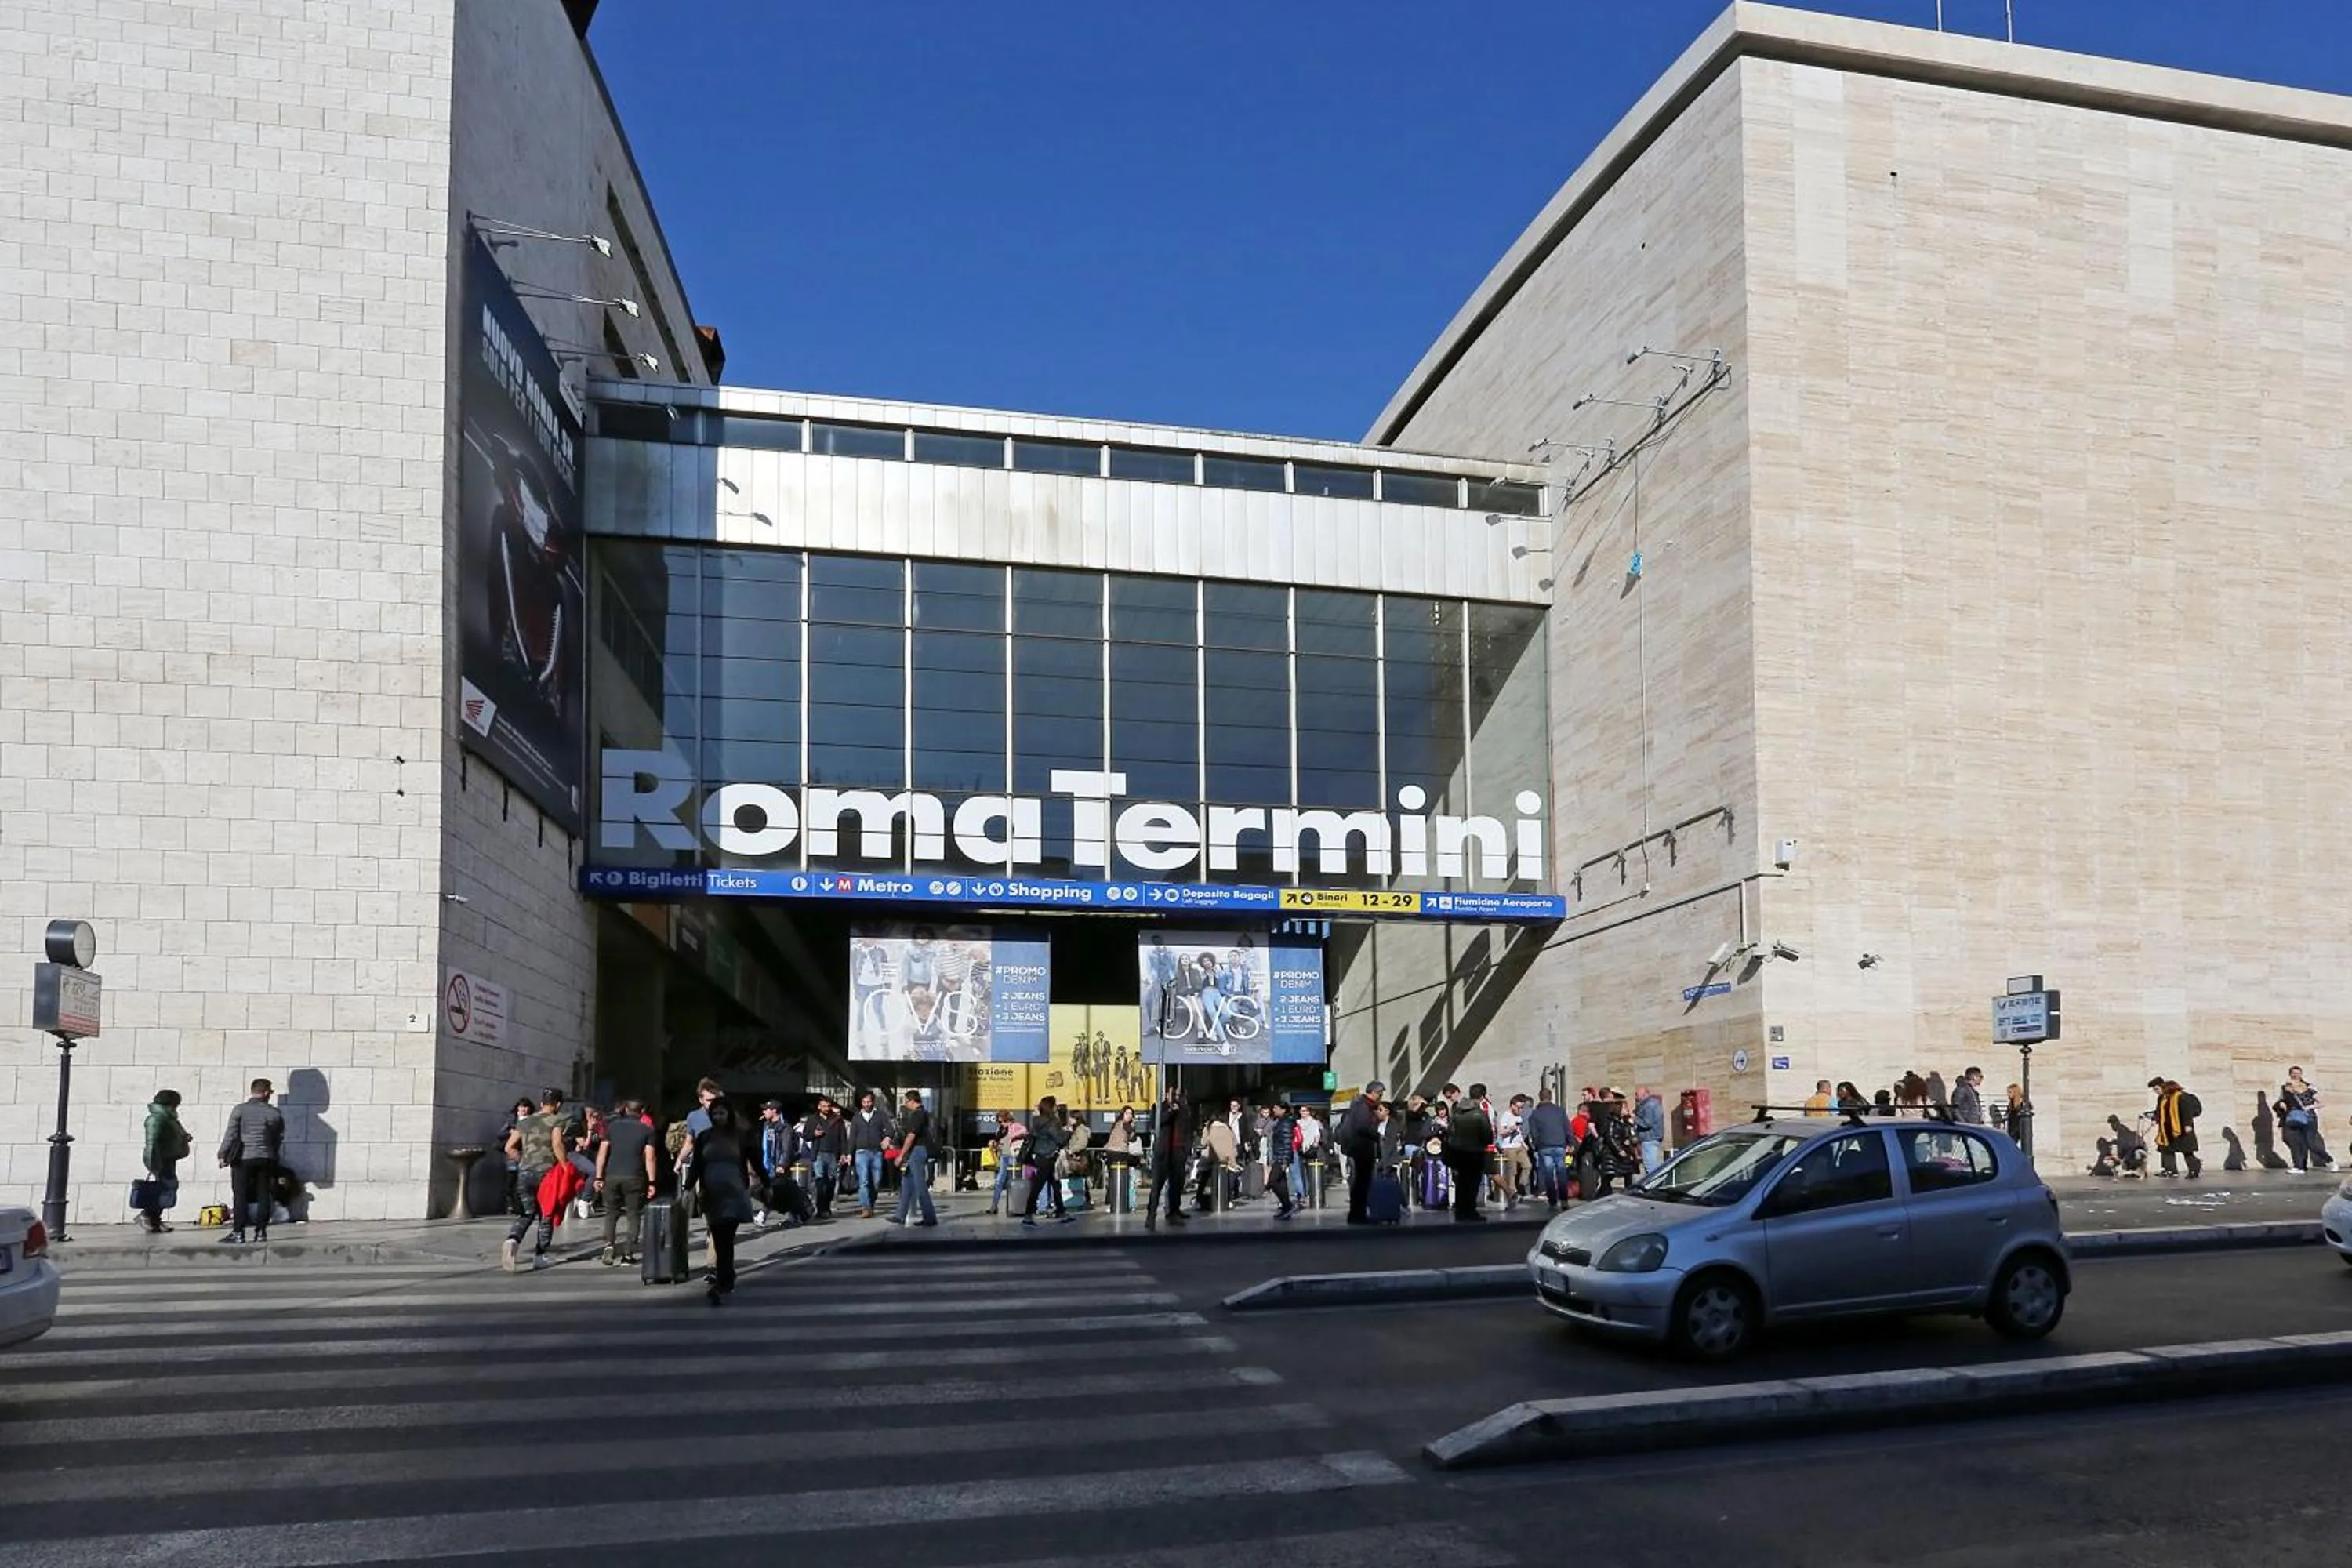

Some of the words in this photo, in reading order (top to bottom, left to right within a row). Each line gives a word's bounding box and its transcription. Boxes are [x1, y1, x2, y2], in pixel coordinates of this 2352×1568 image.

[482, 336, 507, 390] SOLO
[483, 304, 522, 386] NUOVO
[526, 369, 559, 445] HONDA
[629, 871, 703, 889] Biglietti
[709, 874, 757, 888] Tickets
[858, 879, 913, 893] Metro
[1008, 883, 1091, 902] Shopping
[1183, 888, 1230, 899] Deposito
[1233, 891, 1274, 901] Bagagli
[1317, 892, 1348, 902] Binari
[1362, 894, 1379, 906] 12
[1392, 895, 1412, 907] 29
[1455, 897, 1500, 906] Fiumicino
[1503, 898, 1553, 908] Aeroporto
[995, 965, 1047, 976] #PROMO
[1273, 971, 1319, 980] #PROMO
[1011, 992, 1045, 1001] JEANS
[1288, 996, 1319, 1004] JEANS
[1011, 1012, 1046, 1022] JEANS
